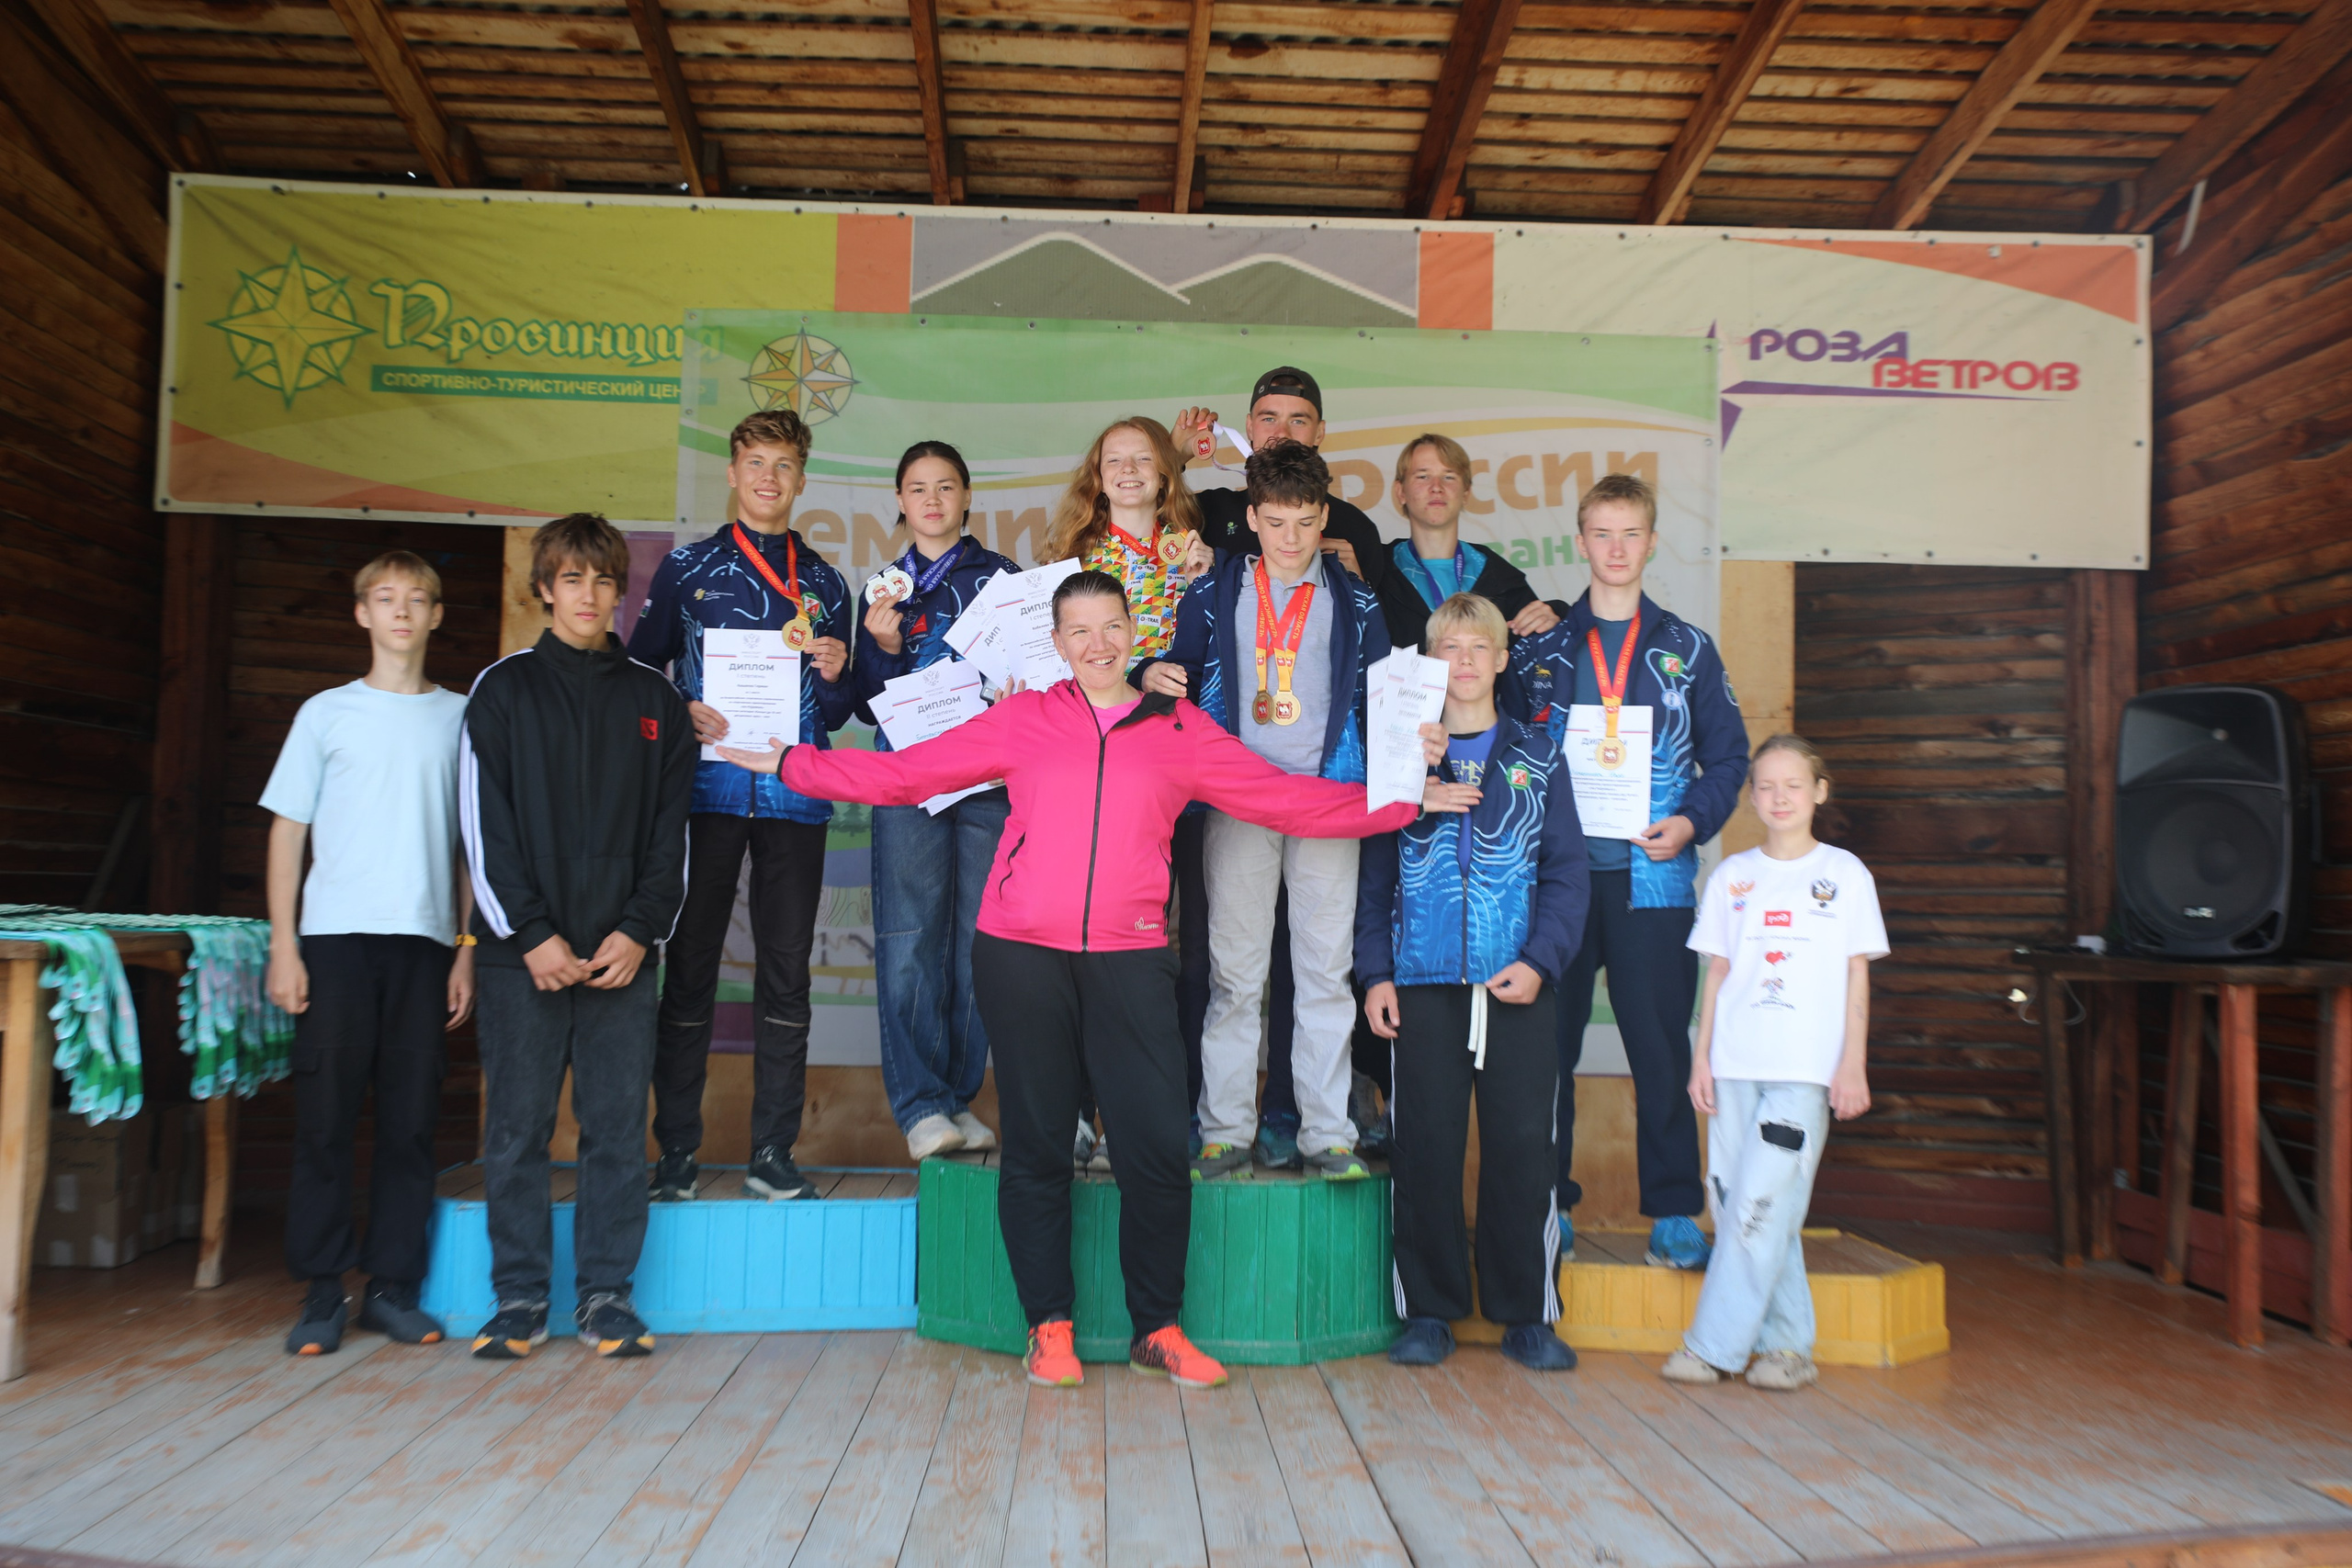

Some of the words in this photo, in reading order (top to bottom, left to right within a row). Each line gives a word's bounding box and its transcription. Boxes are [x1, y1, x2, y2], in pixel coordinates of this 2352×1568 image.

[1749, 329, 1909, 362] РОЗА
[381, 371, 644, 398] СПОРТИВНО-ТУРИСТИЧЕСКИЙ
[1872, 357, 2081, 391] ВЕТРОВ
[1020, 600, 1053, 616] ДИПЛО
[1261, 595, 1278, 638] ЧЕЛЯБИНСКАЯ
[1292, 610, 1306, 640] ОБЛАСТЬ
[729, 663, 775, 671] ДИПЛОМ
[918, 695, 962, 714] ДИПЛОМ
